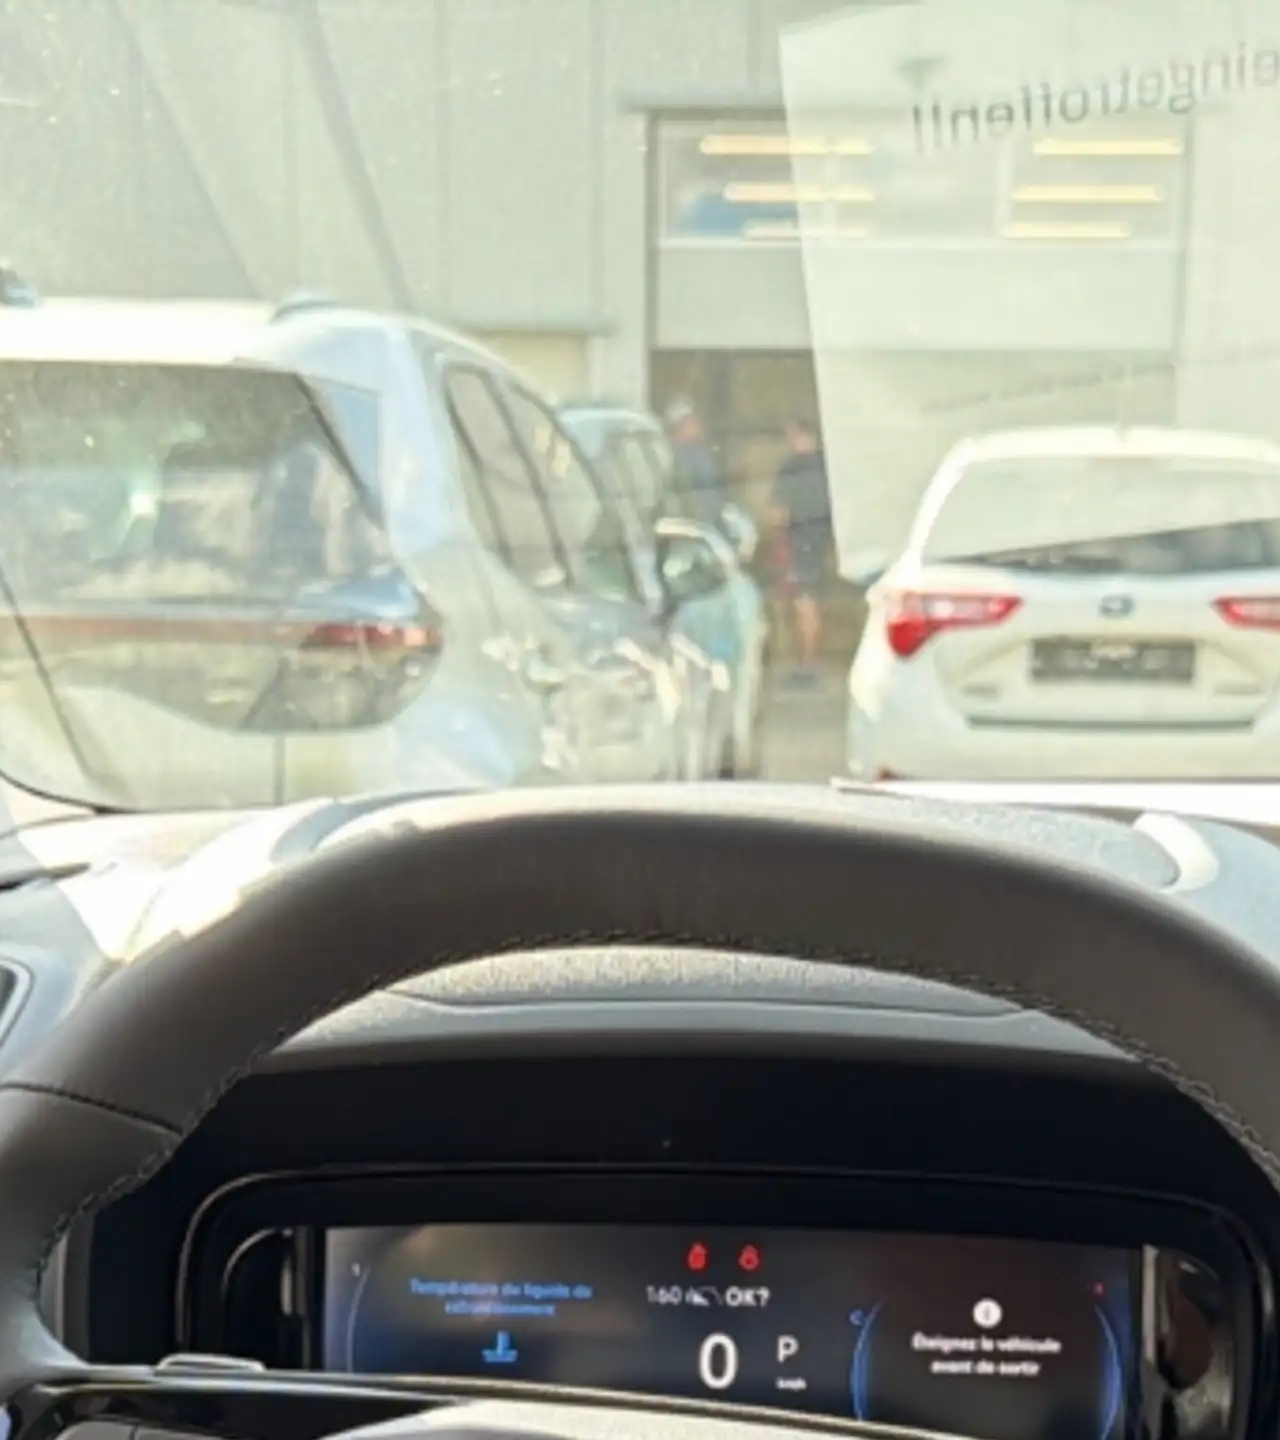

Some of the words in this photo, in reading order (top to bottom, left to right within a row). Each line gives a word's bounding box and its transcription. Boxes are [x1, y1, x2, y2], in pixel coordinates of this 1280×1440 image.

[699, 1333, 739, 1389] 0
[776, 1334, 799, 1363] P
[975, 1358, 995, 1374] de
